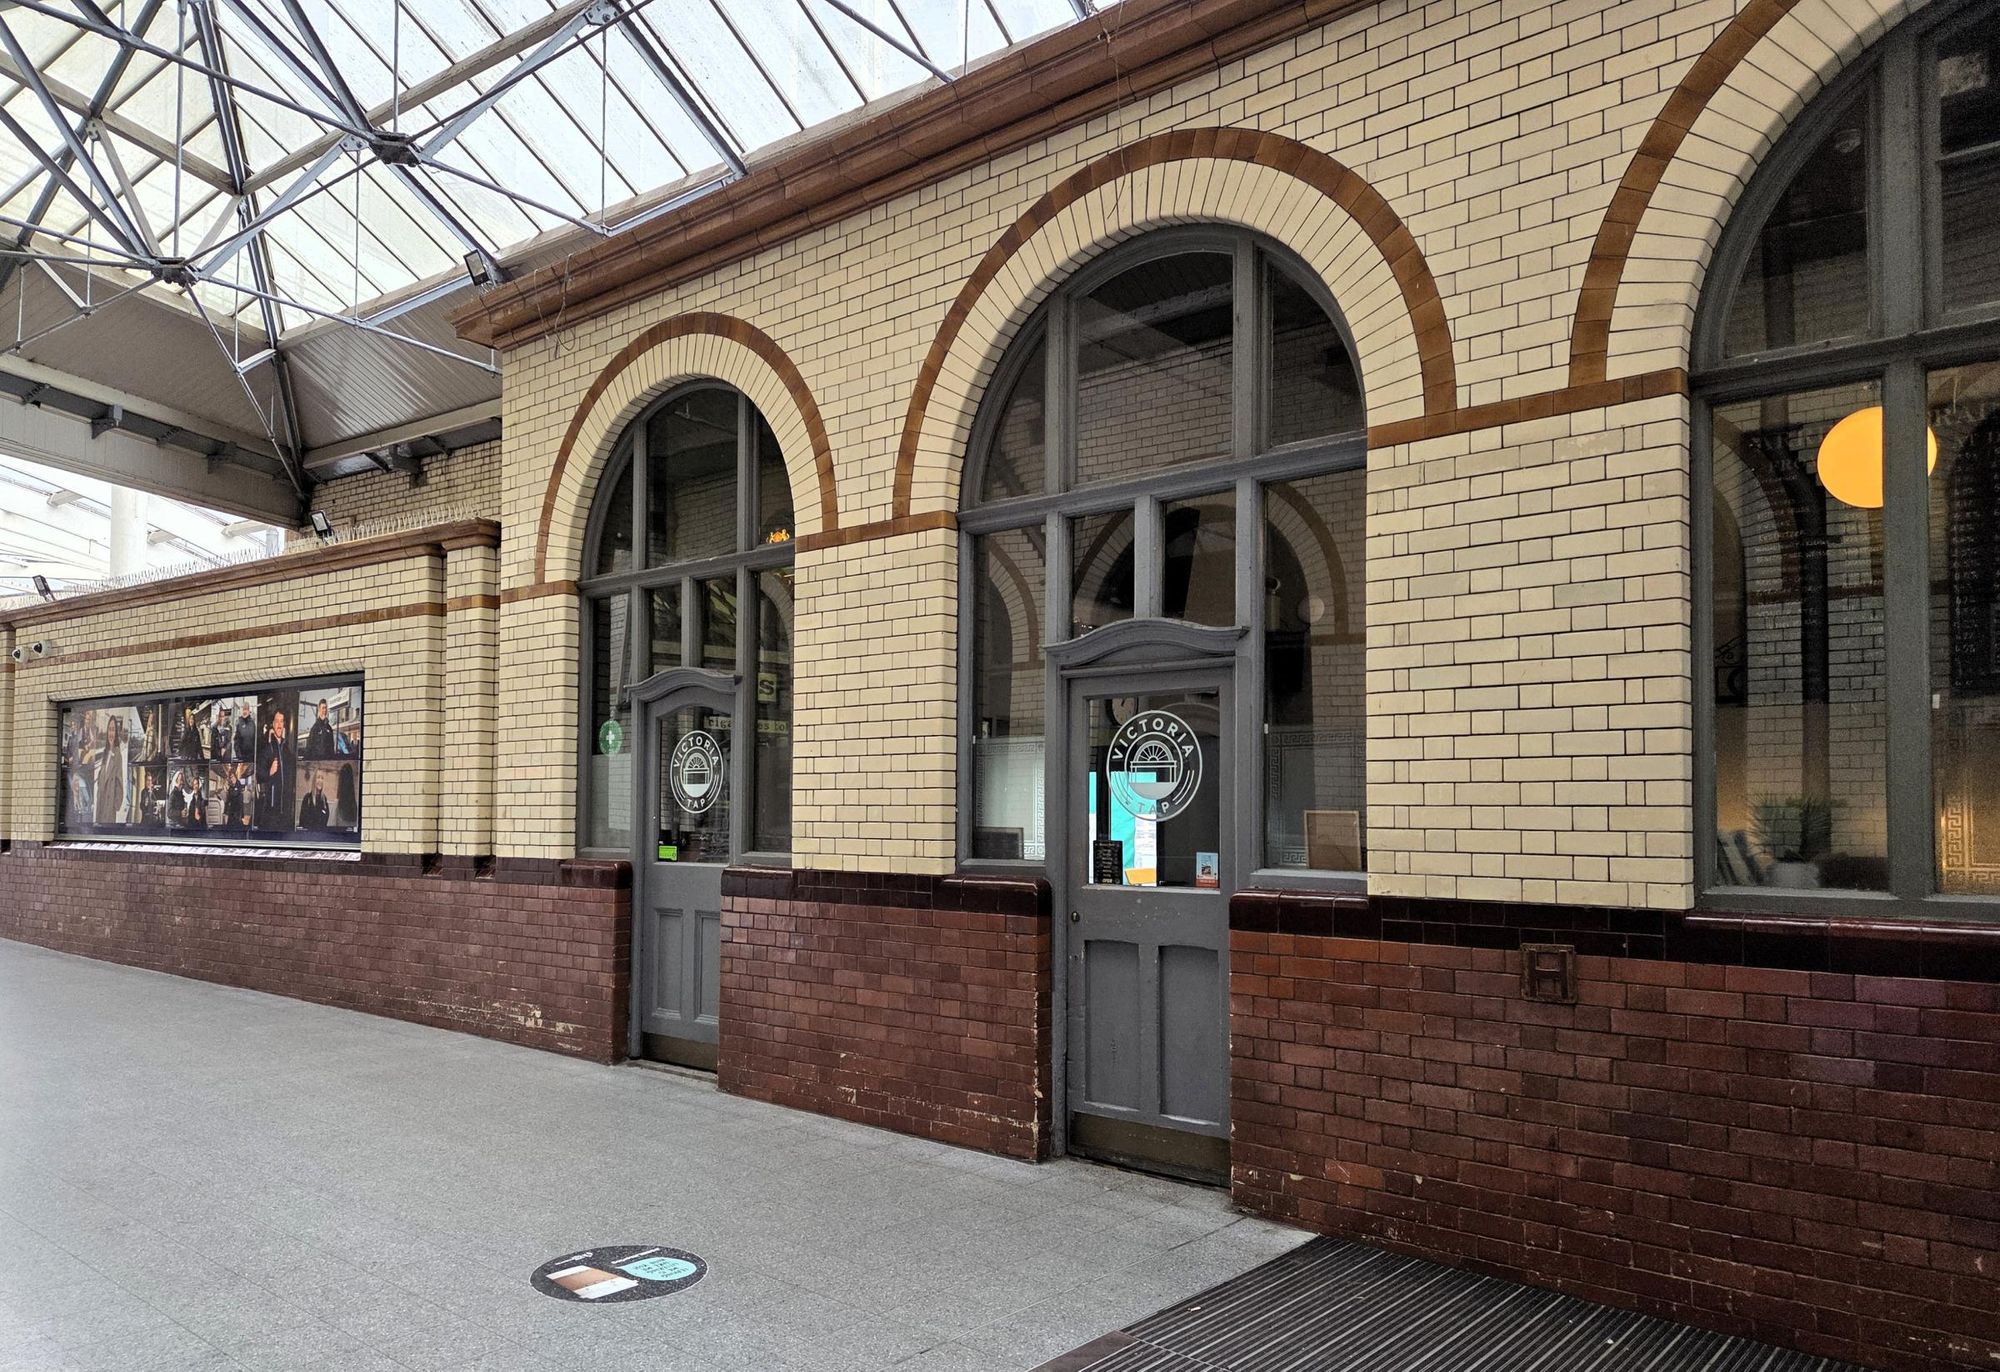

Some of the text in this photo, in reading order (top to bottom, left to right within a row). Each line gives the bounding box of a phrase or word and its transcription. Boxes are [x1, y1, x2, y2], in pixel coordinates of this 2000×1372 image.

[1112, 718, 1195, 760] VICTORIA
[673, 736, 719, 768] VICTORIA
[687, 798, 706, 809] TAP
[1137, 801, 1171, 815] TAP
